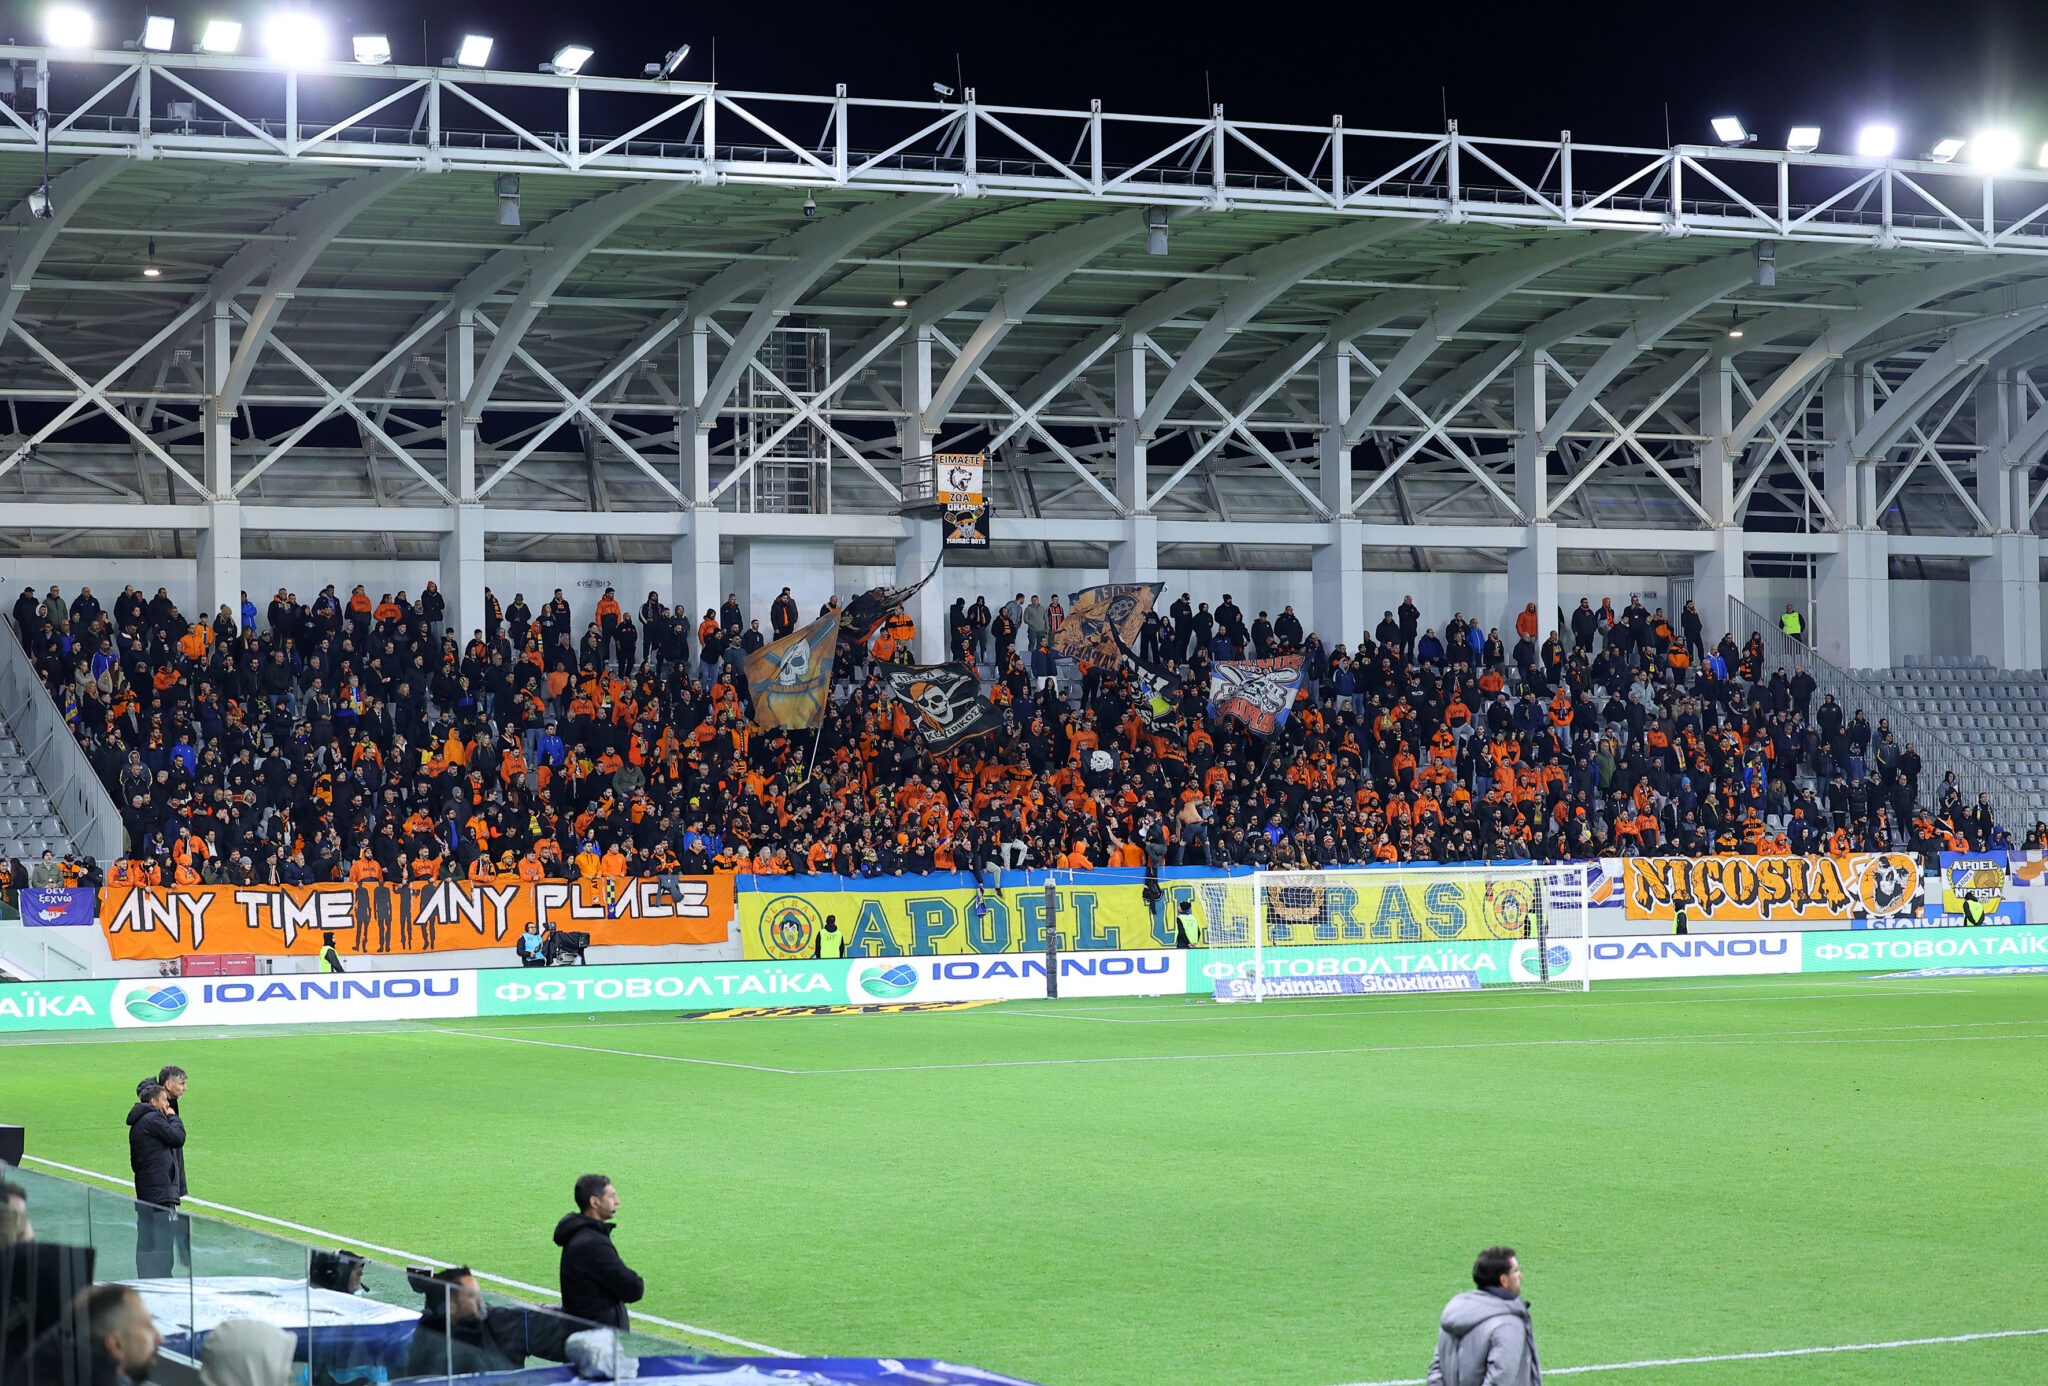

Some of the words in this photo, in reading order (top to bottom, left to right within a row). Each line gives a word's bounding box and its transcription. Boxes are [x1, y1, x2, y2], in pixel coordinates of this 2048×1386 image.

[939, 455, 981, 465] ΕΙΜΑΣΤΕ
[949, 493, 970, 502] ΖΩΑ
[925, 709, 980, 741] ΚΕΤΡΙΚΟΣ
[1952, 860, 1998, 870] APOEL
[38, 893, 72, 904] ξεχνώ
[1632, 855, 1852, 919] NICOSIA
[109, 886, 216, 951] ANY
[235, 888, 355, 949] TIME
[414, 876, 521, 942] ANY
[534, 876, 711, 938] PLACE
[764, 900, 817, 924] ULTRAS
[844, 891, 1120, 957] APOEL
[932, 956, 1170, 980] IOANNOU
[203, 976, 460, 1003] IOANNOU
[495, 968, 833, 1002] ΦΩΤΟΒΟΛΤΑΪΚΑ
[1361, 973, 1471, 992] Stoiximan
